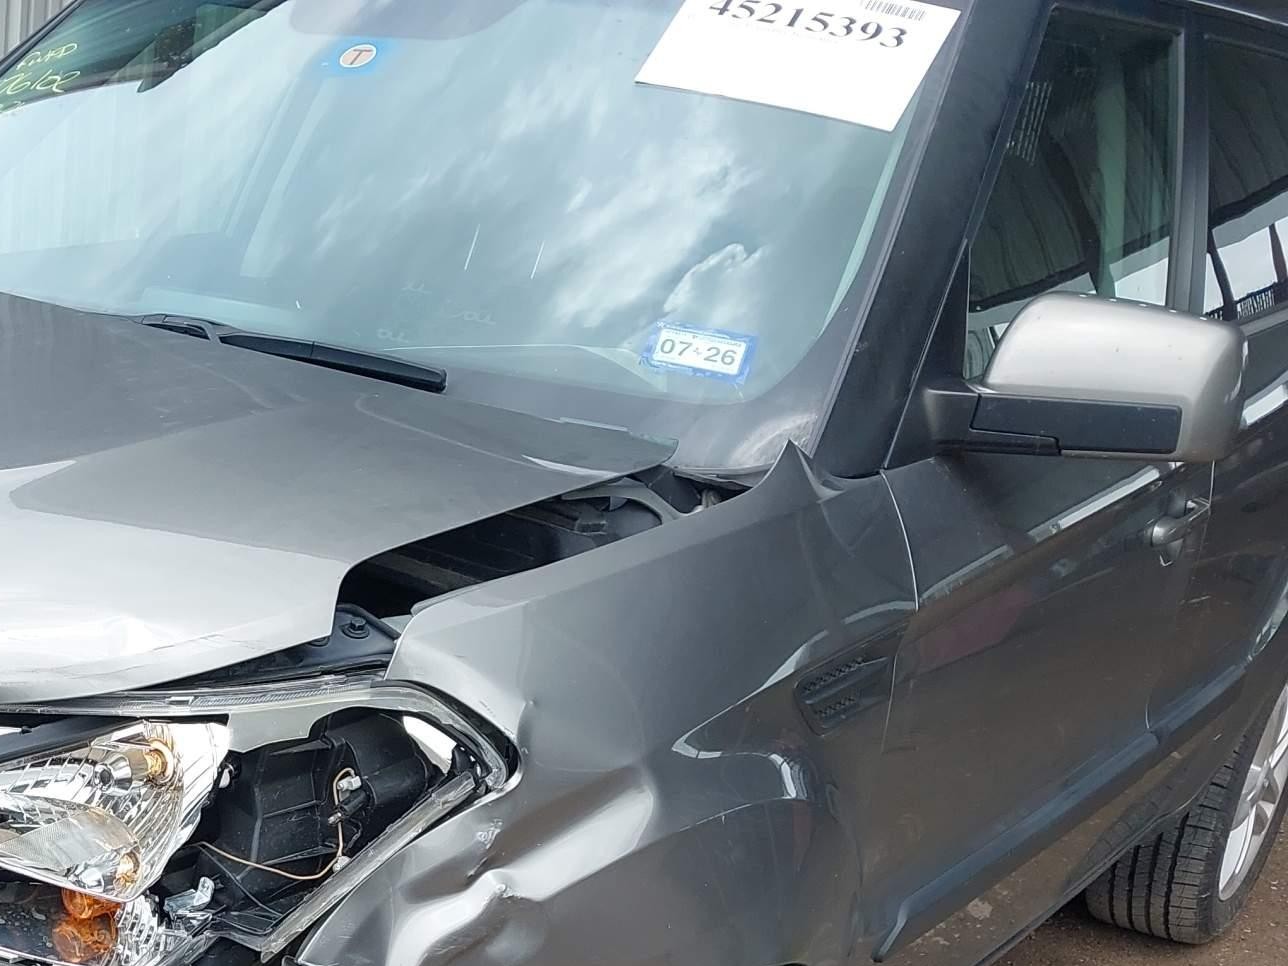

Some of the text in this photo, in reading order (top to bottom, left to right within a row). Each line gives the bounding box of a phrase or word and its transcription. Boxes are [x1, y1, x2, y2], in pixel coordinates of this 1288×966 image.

[709, 0, 908, 48] 45215393
[660, 338, 692, 357] 07
[703, 346, 738, 366] 26
